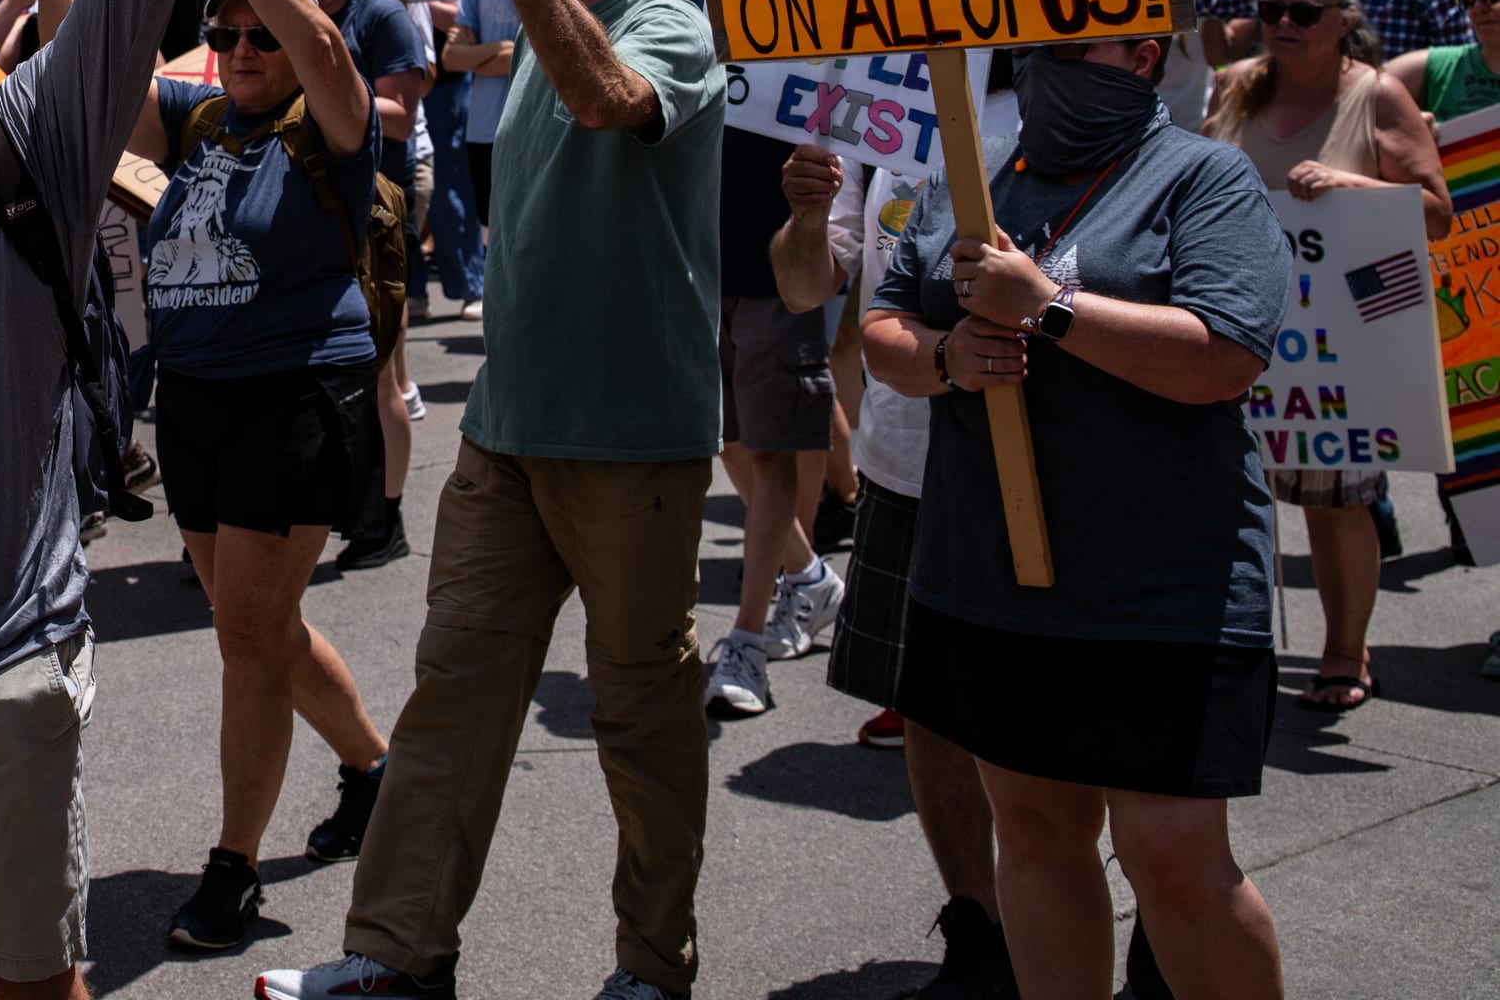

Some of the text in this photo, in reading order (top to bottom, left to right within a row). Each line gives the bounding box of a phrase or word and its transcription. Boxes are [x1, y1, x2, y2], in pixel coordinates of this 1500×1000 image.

[776, 74, 939, 164] EXIST
[1250, 385, 1347, 420] RAN
[1260, 427, 1401, 466] VICES
